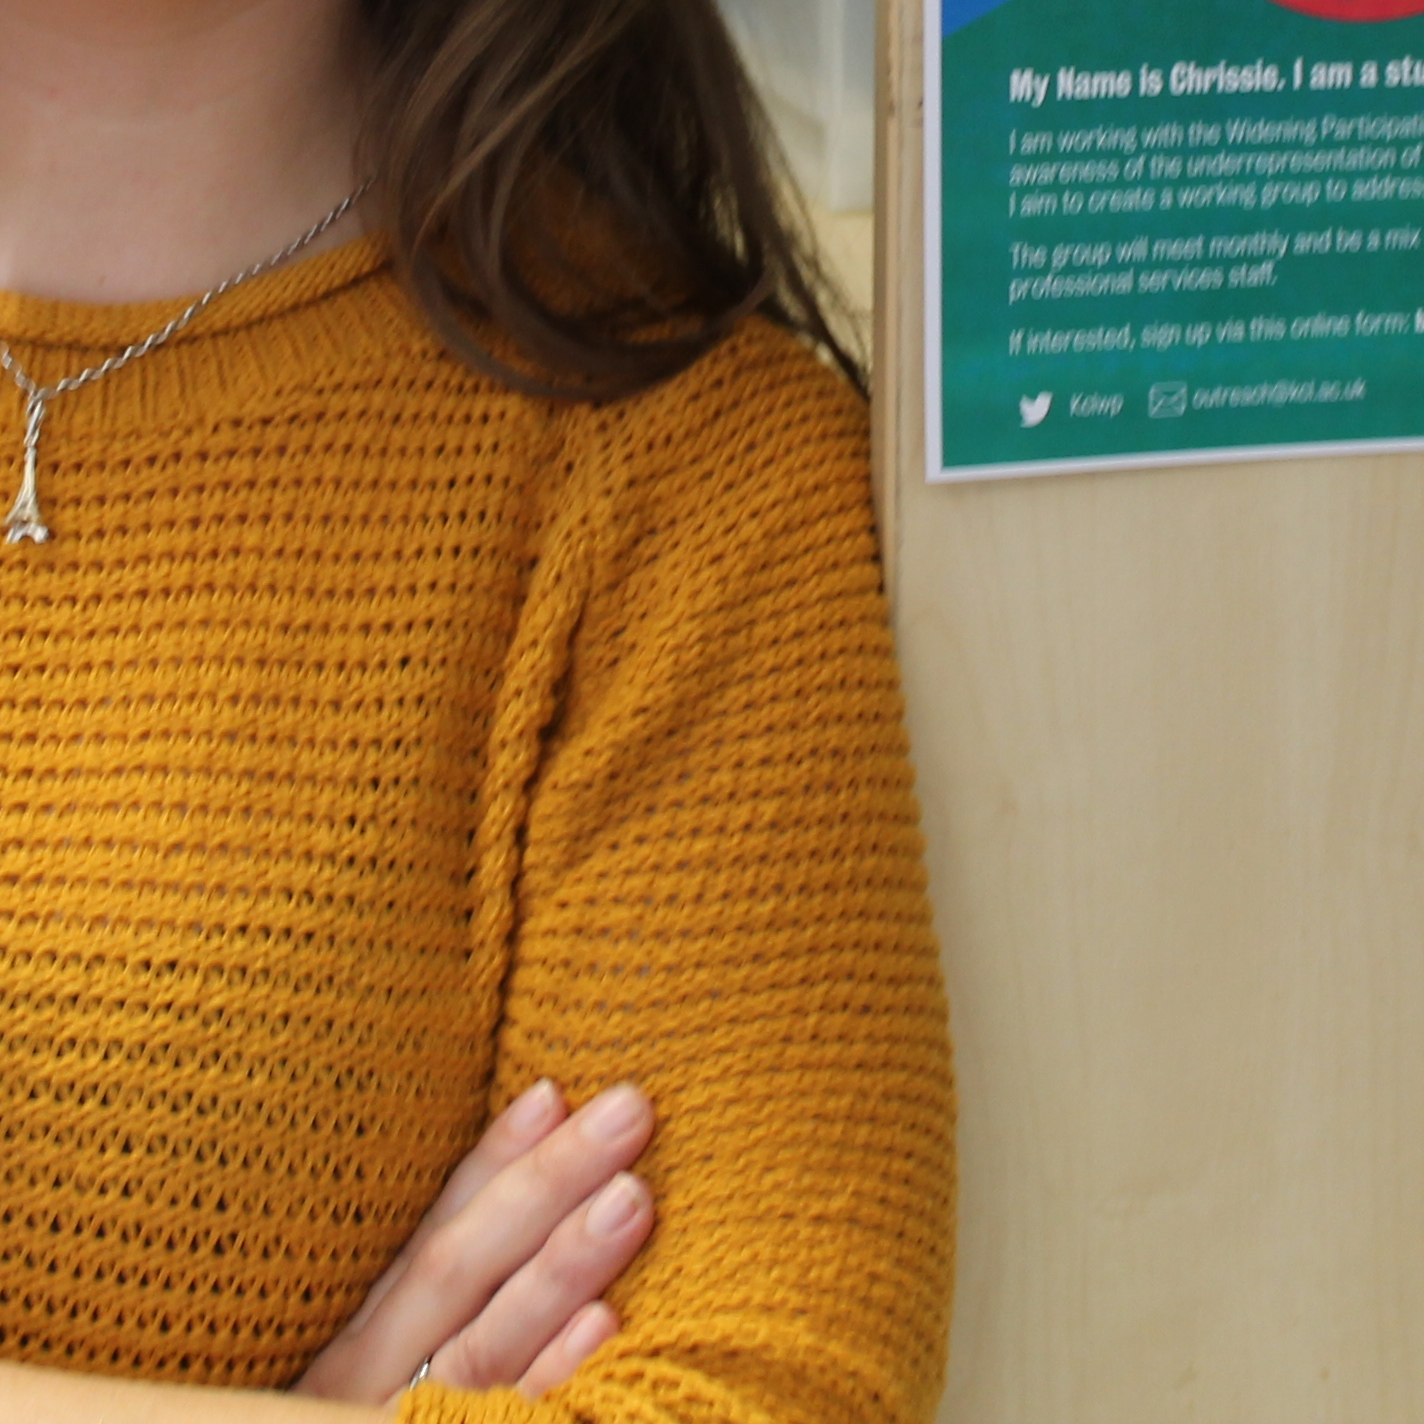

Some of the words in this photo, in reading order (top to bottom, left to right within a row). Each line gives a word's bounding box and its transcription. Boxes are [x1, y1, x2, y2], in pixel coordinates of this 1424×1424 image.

[1009, 67, 1050, 108] My
[1057, 66, 1132, 101] Name
[1139, 63, 1163, 97] is
[1293, 56, 1303, 91] I
[1310, 62, 1353, 91] am
[1360, 60, 1377, 88] a
[1009, 129, 1016, 155] I
[1021, 130, 1052, 155] am
[1057, 124, 1137, 155] working
[1141, 121, 1184, 149] with
[1188, 120, 1221, 146] the
[1226, 117, 1317, 147] Widening
[1009, 159, 1119, 187] awareness
[1124, 154, 1145, 180] of
[1150, 155, 1183, 180] the
[1187, 145, 1397, 180] underrepresentation
[1401, 141, 1424, 169] of
[1009, 191, 1016, 218] I
[1020, 190, 1057, 217] aim
[1062, 190, 1084, 215] to
[1088, 187, 1155, 214] create
[1160, 188, 1174, 211] a
[1178, 180, 1257, 211] working
[1261, 180, 1320, 211] group
[1326, 178, 1347, 202] to
[1010, 241, 1047, 270] The
[1052, 242, 1112, 272] group
[1116, 236, 1149, 263] will
[1152, 234, 1204, 262] meet
[1209, 230, 1289, 260] monthly
[1293, 227, 1332, 255] and
[1336, 226, 1362, 253] be
[1367, 229, 1380, 252] a
[1385, 225, 1421, 251] mix
[1009, 268, 1134, 305] professional
[1138, 266, 1224, 293] services
[1009, 328, 1024, 356] If
[1027, 322, 1136, 355] interested,
[1140, 321, 1182, 351] sign
[1185, 321, 1212, 349] up
[1216, 318, 1245, 344] via
[1249, 314, 1286, 342] this
[1290, 312, 1351, 339] online
